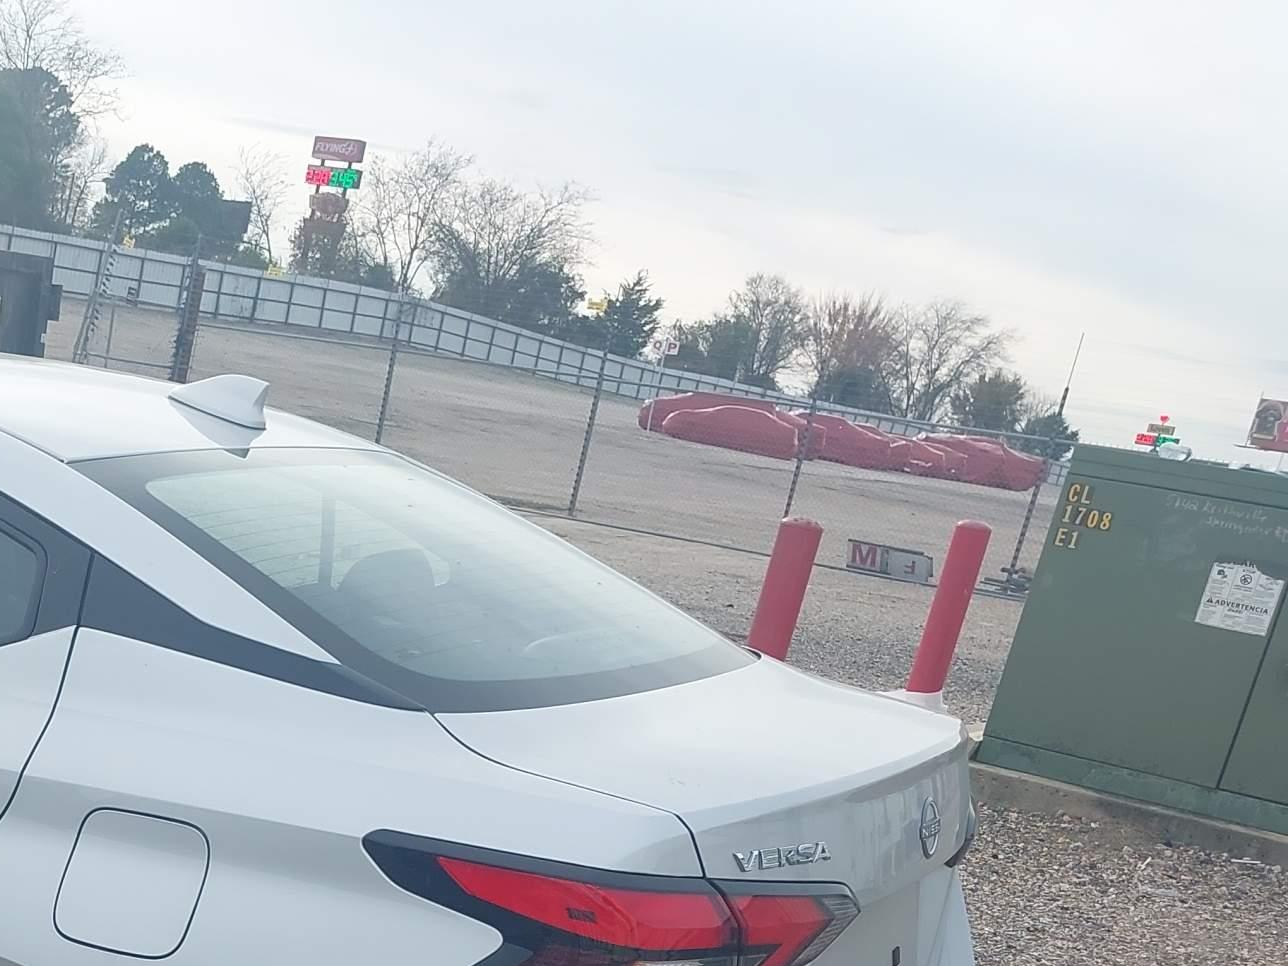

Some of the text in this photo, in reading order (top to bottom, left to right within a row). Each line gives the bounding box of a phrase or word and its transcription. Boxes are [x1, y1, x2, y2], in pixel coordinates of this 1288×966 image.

[1068, 484, 1091, 504] CL
[1061, 504, 1112, 530] 1708
[1054, 527, 1079, 549] E1
[1214, 599, 1269, 615] ADVERTENCIA
[732, 840, 832, 872] VERSA
